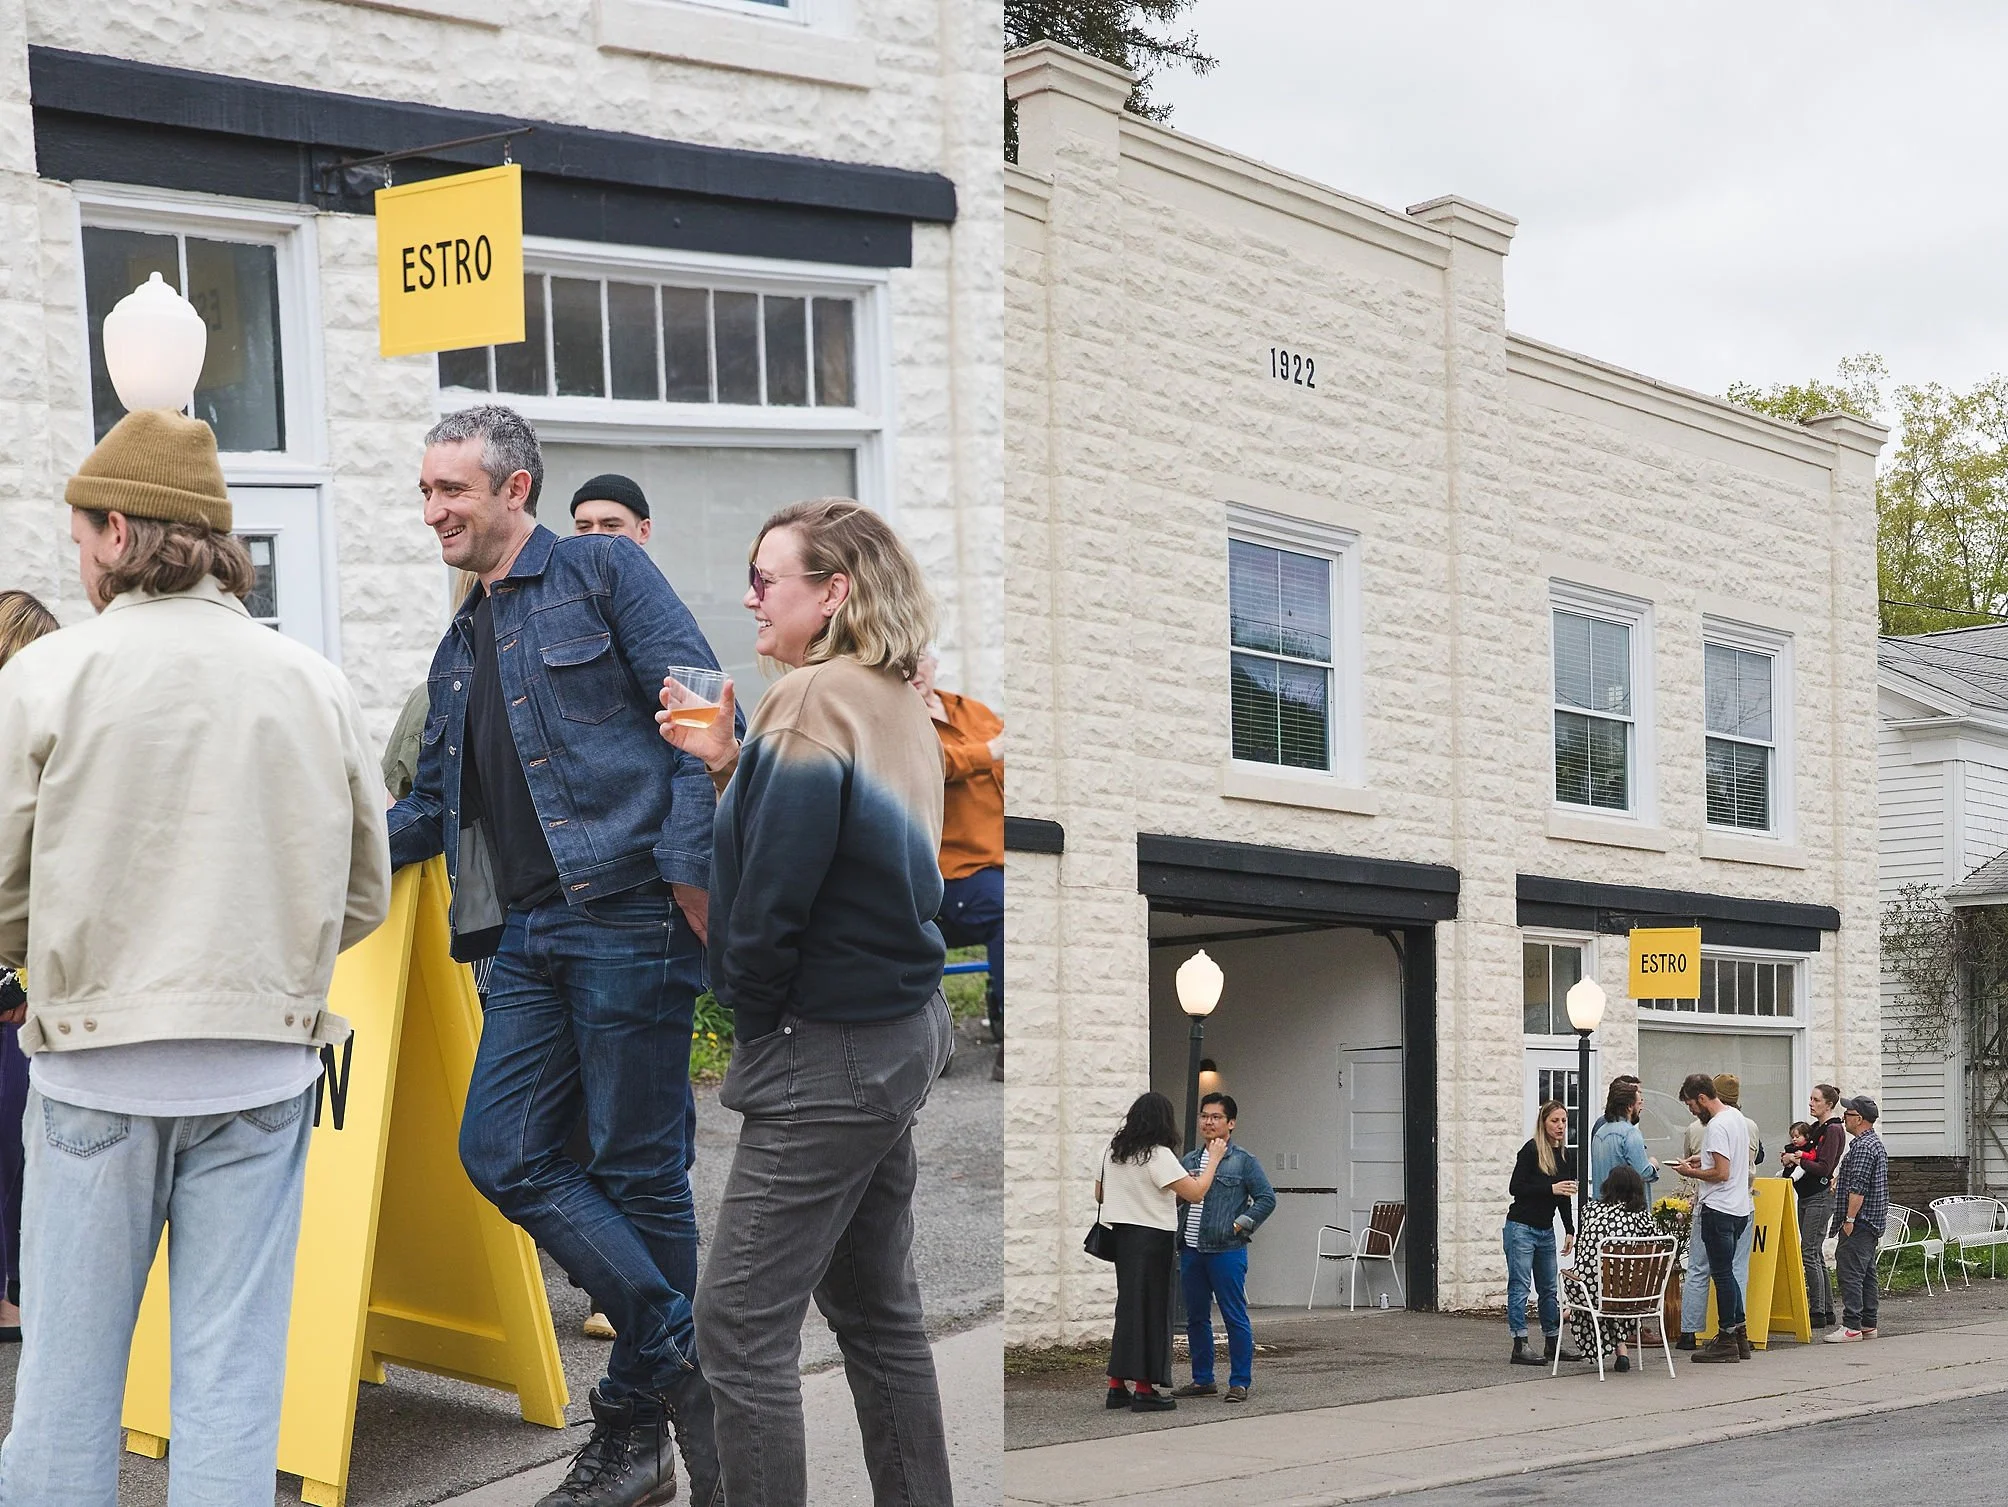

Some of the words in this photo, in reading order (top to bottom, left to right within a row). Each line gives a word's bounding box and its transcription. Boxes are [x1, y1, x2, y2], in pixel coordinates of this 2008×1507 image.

[402, 234, 492, 293] ESTRO
[1270, 347, 1316, 389] 1922
[1641, 953, 1687, 974] ESTRO
